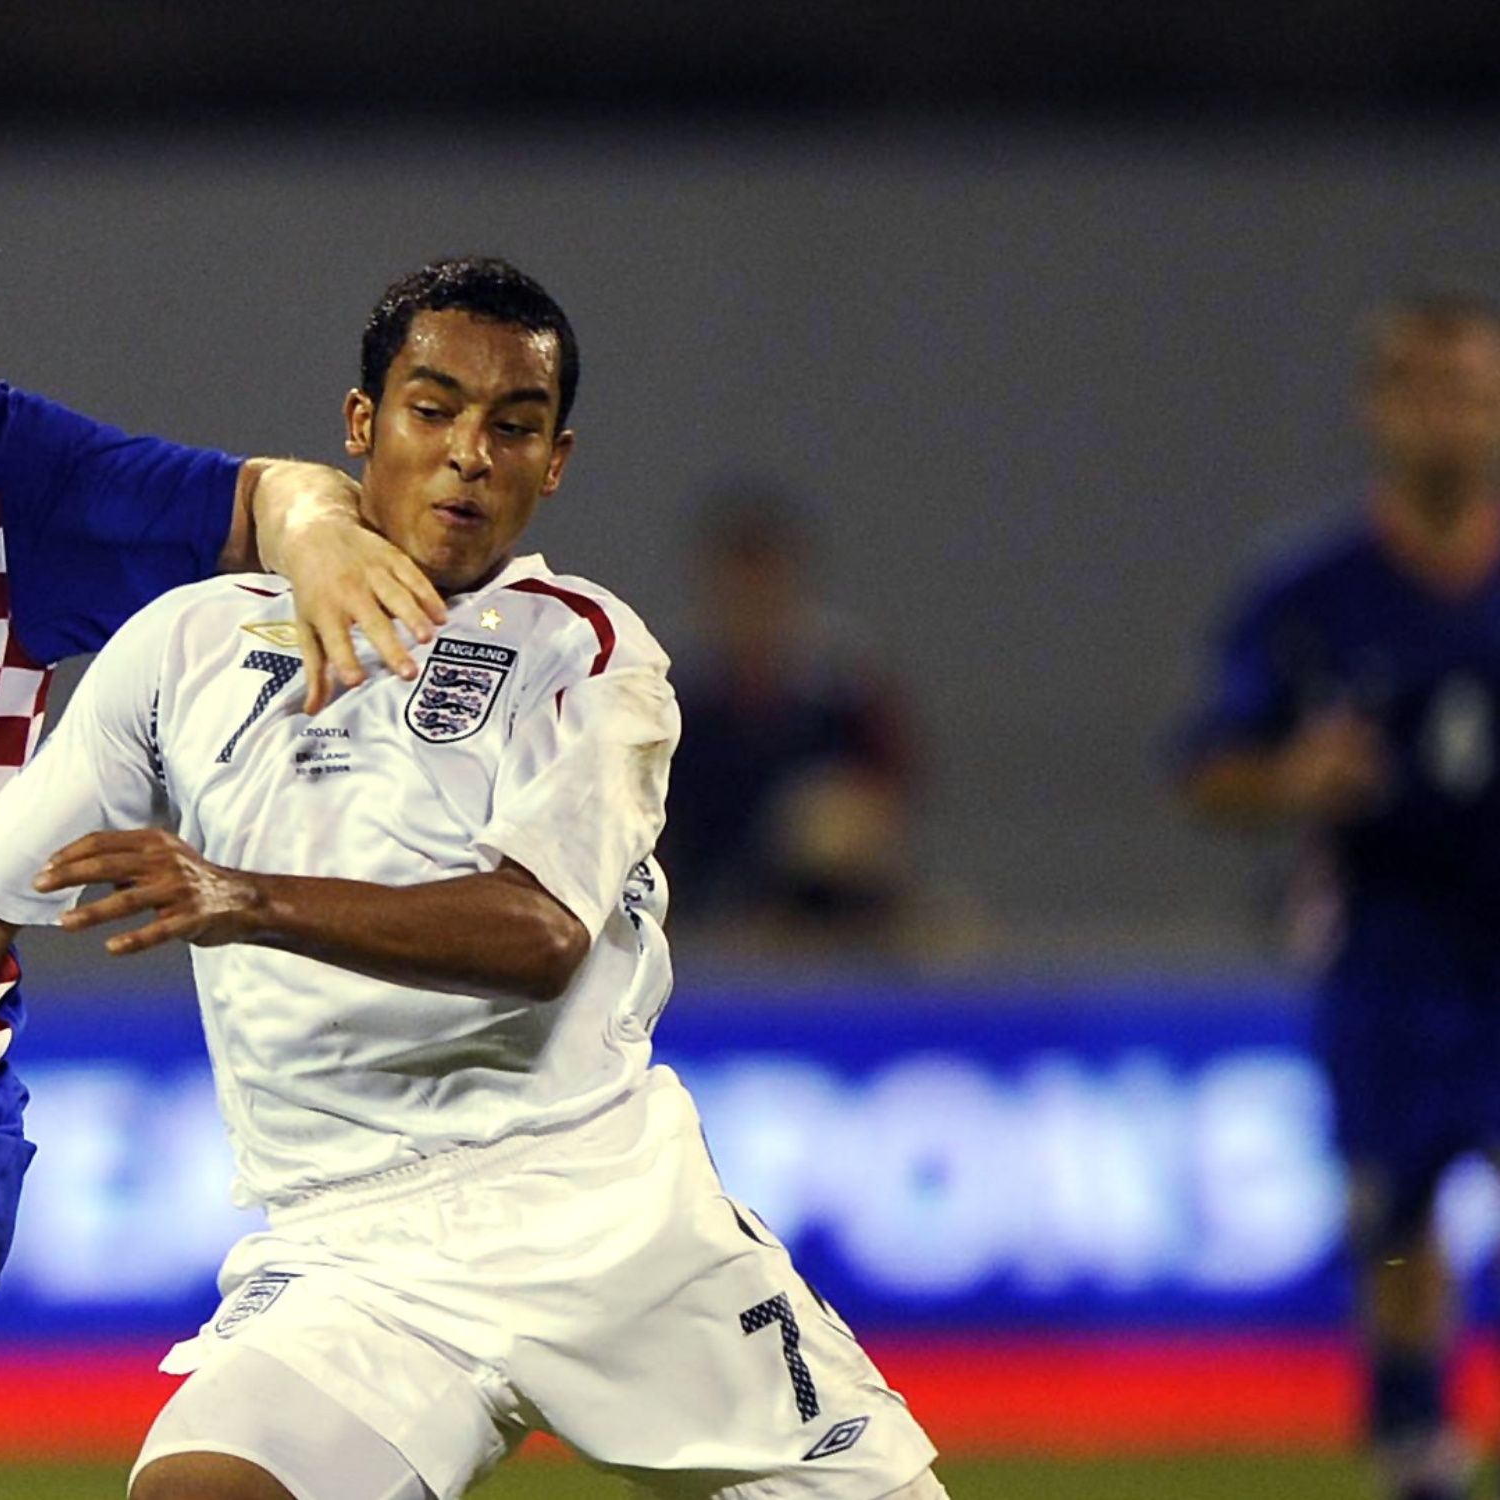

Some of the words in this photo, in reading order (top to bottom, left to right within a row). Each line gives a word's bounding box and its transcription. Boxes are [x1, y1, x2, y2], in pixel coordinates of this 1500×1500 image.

[215, 649, 303, 764] 7
[439, 641, 509, 663] ENGLAND
[739, 1291, 820, 1424] 7
